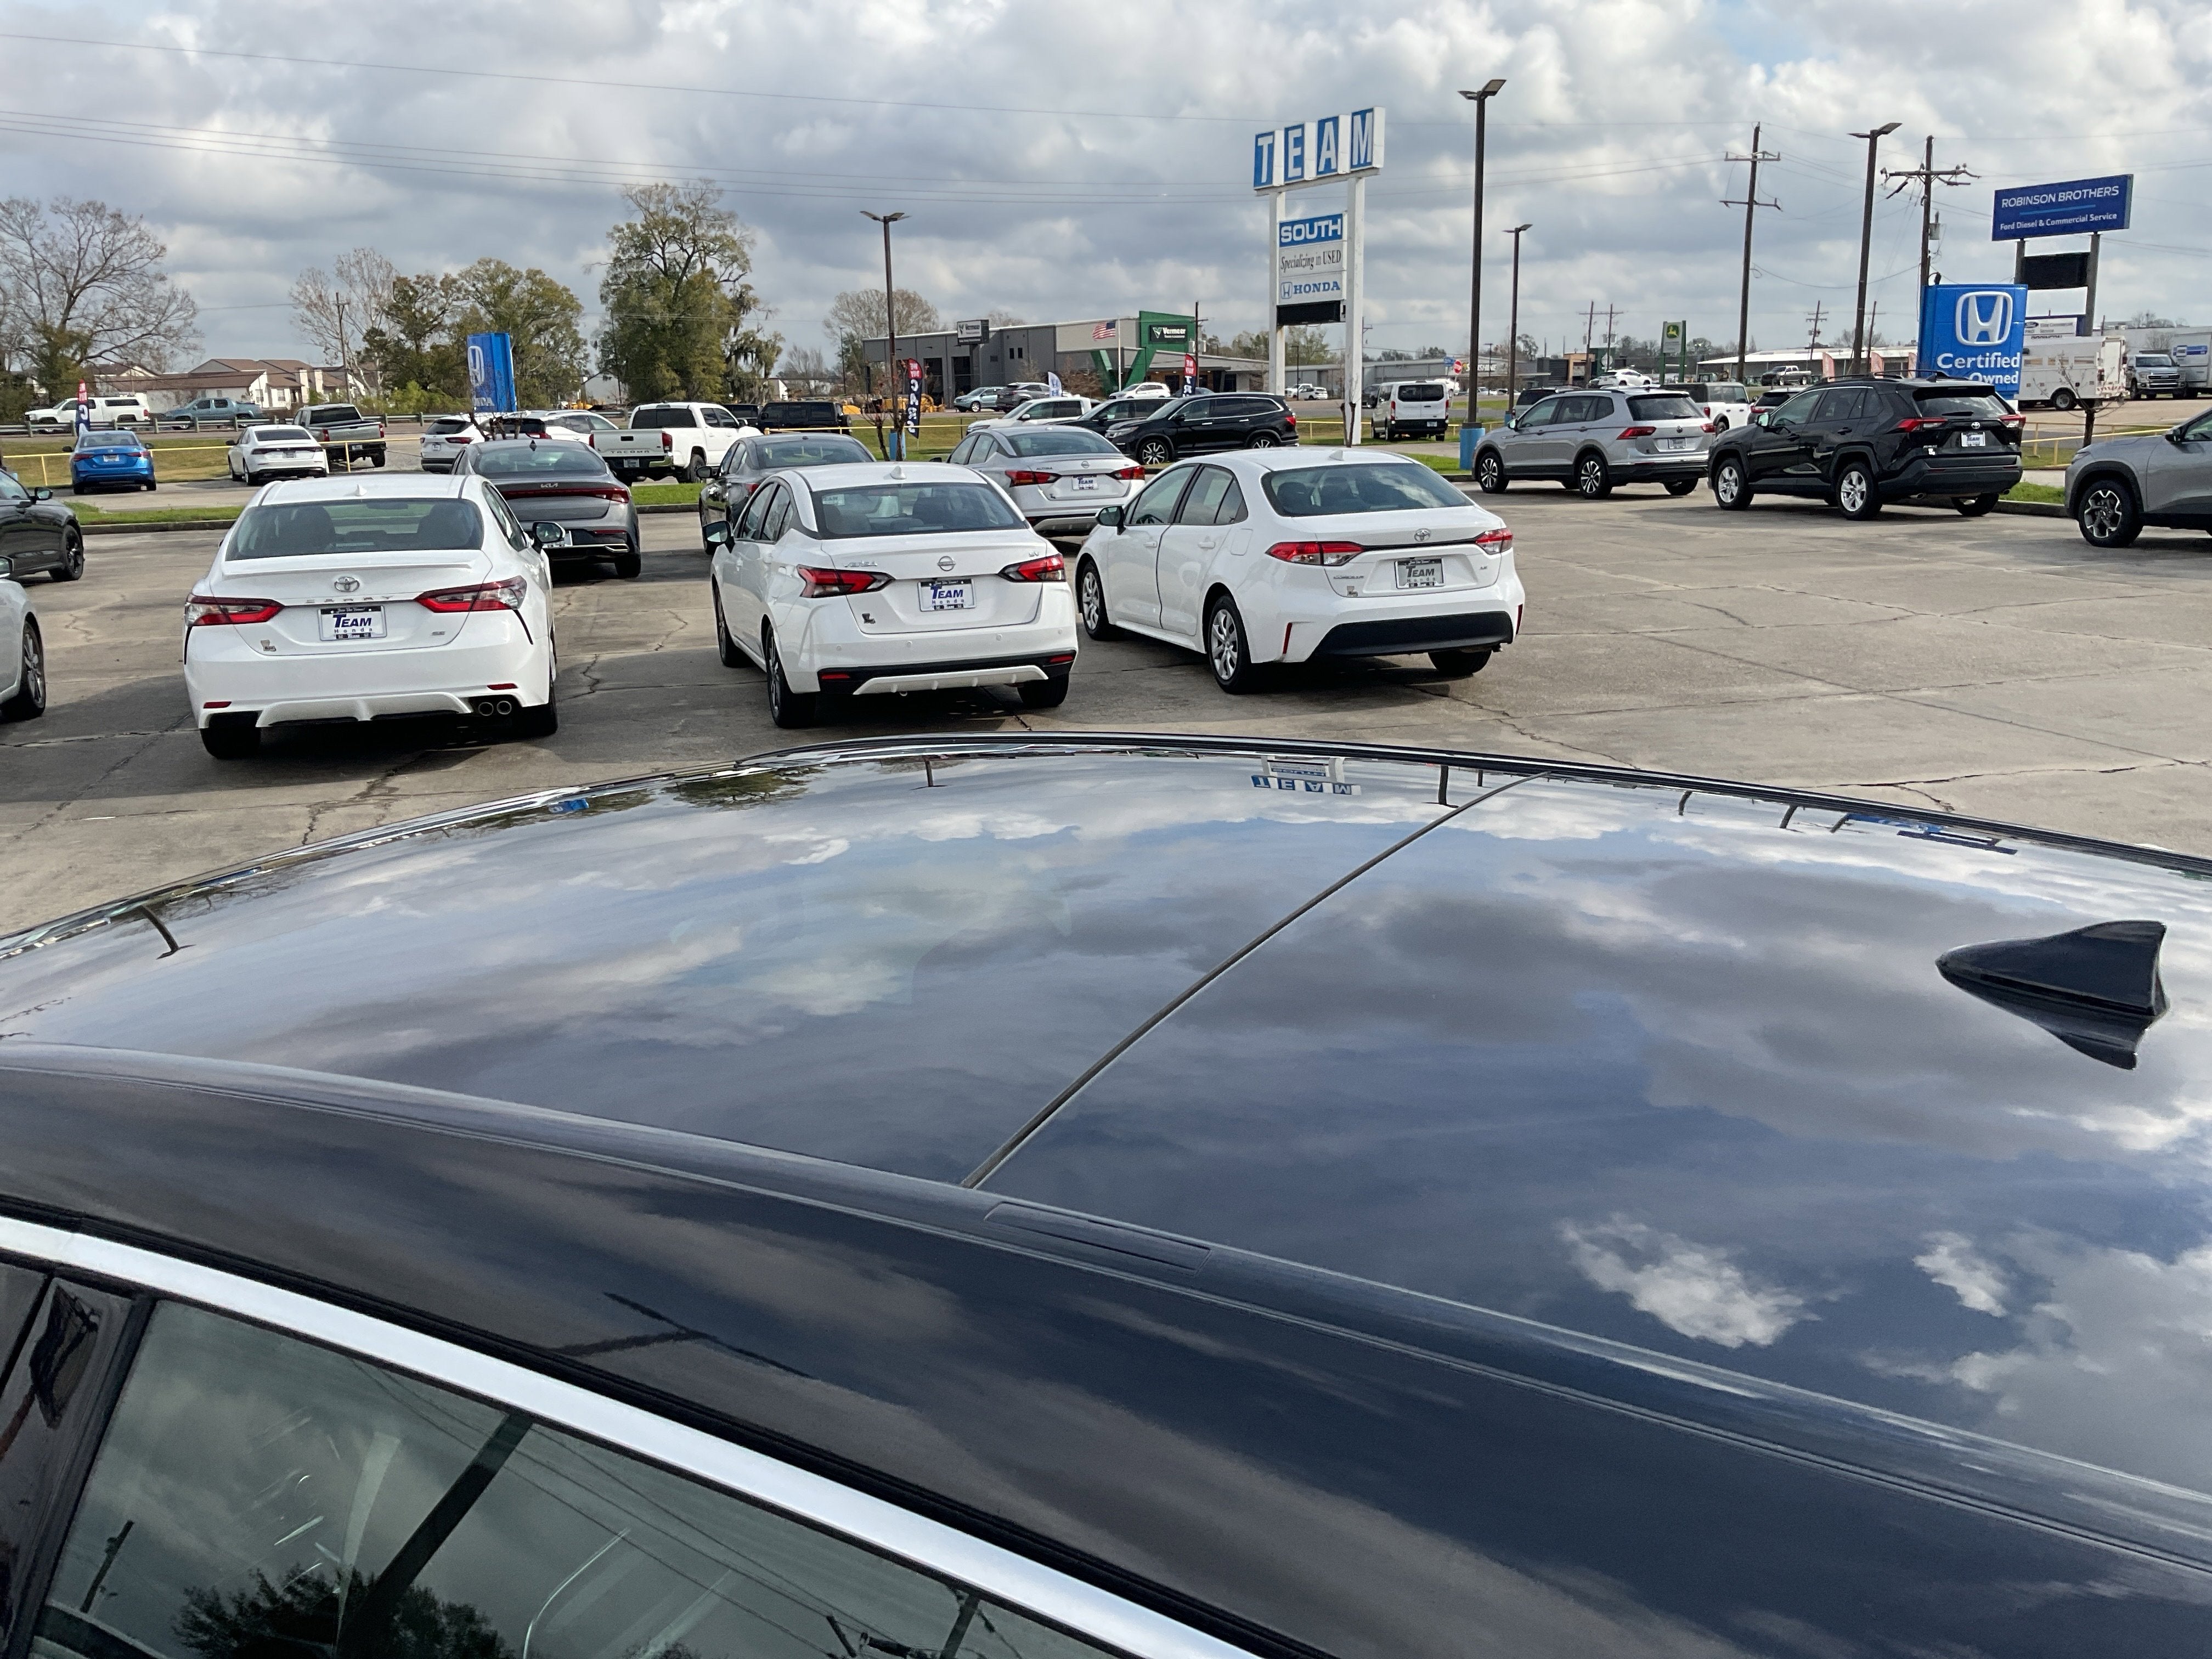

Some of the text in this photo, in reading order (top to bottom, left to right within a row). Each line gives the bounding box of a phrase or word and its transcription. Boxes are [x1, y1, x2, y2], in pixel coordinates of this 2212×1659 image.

[1257, 111, 1373, 183] TEAM
[2001, 186, 2119, 208] ROBINSON BROTHERS
[2017, 221, 2037, 229] Diesel
[2046, 214, 2088, 226] Commercial
[2089, 212, 2117, 222] Service
[1280, 218, 1341, 243] SOUTH
[1280, 250, 1341, 273] Specializing in USED
[1293, 281, 1340, 295] HONDA
[1937, 352, 2021, 369] Certified
[1406, 565, 1435, 578] TEAM
[930, 584, 964, 599] TEAM
[332, 614, 372, 628] TEAM
